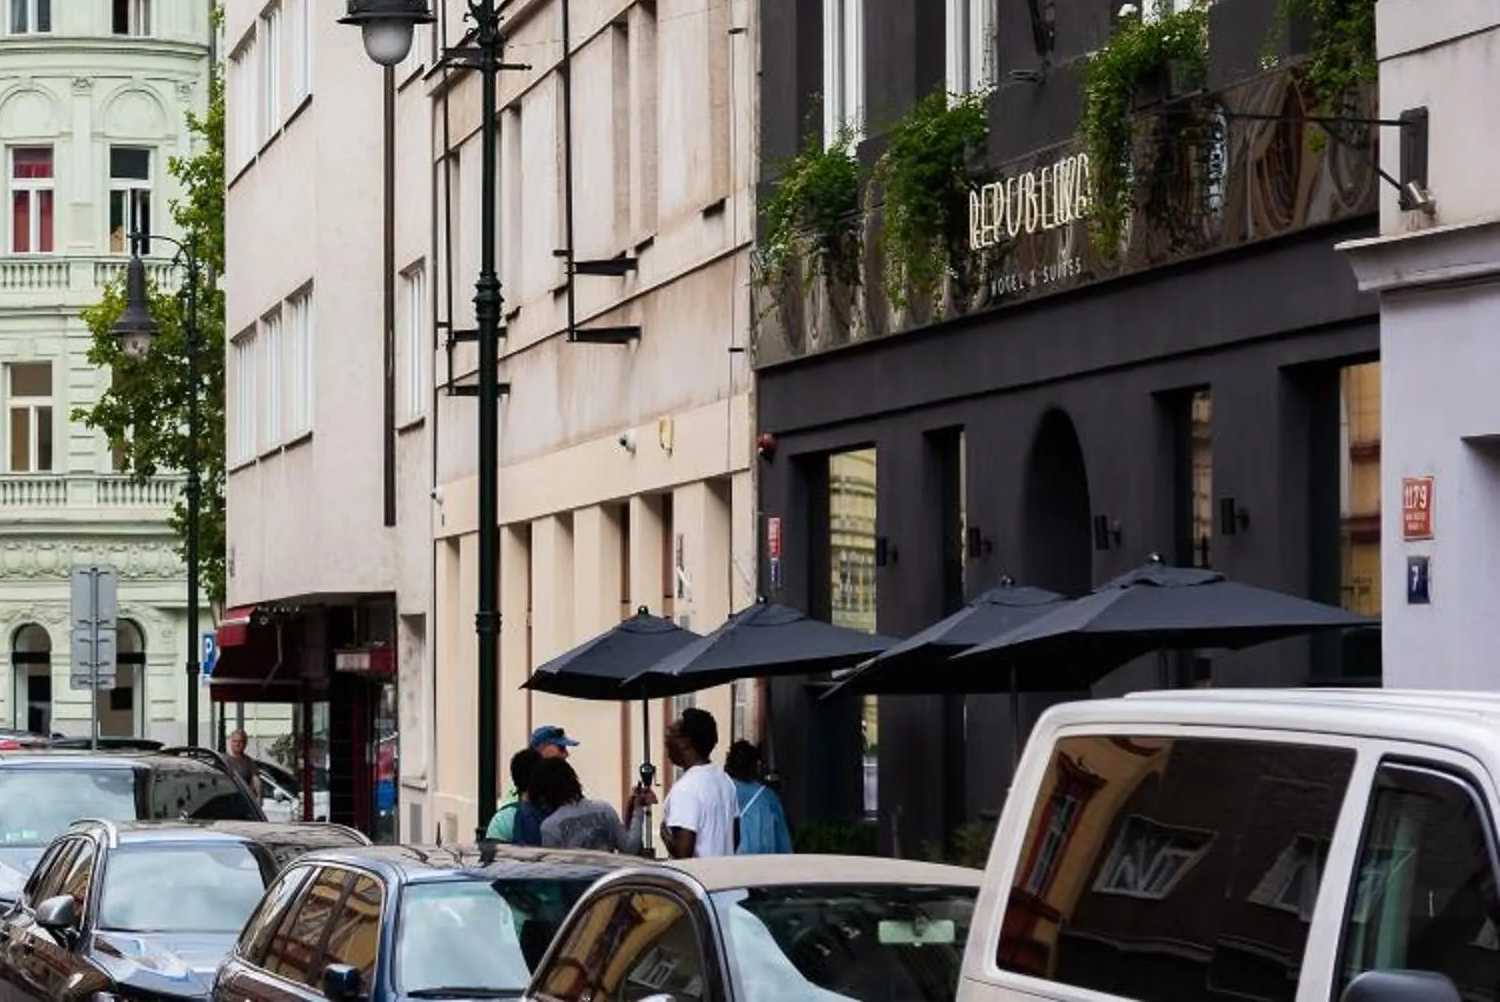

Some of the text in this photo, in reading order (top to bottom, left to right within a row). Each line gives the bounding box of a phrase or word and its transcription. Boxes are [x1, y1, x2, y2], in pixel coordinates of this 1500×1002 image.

[990, 272, 1025, 297] HOTEL
[1042, 256, 1083, 284] SUITES
[1411, 565, 1419, 591] 7
